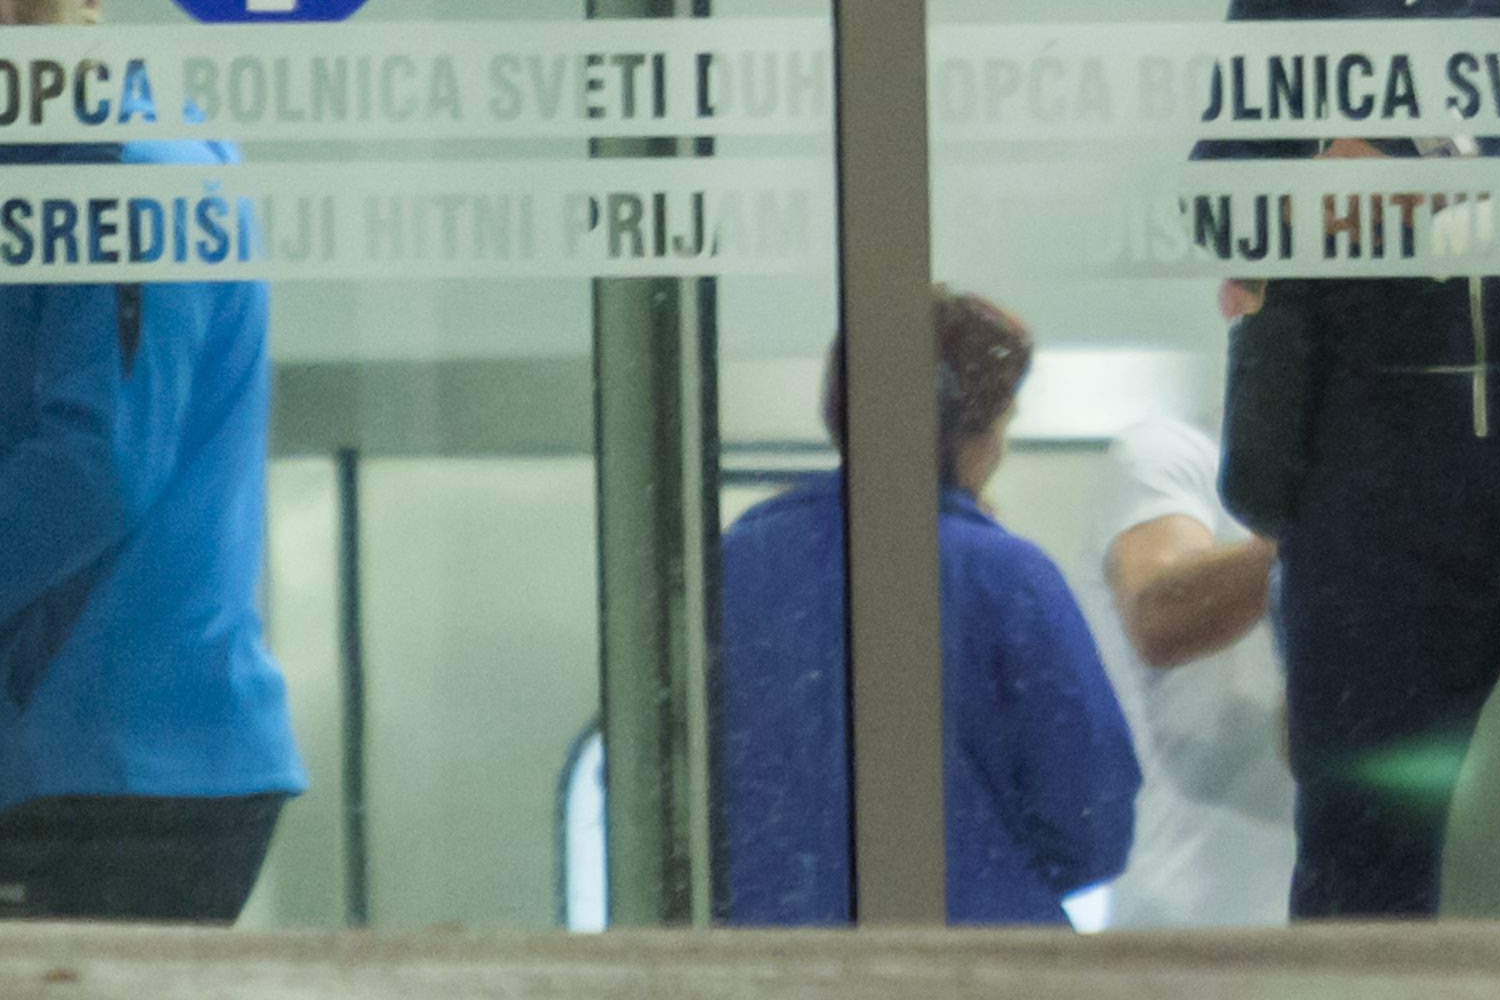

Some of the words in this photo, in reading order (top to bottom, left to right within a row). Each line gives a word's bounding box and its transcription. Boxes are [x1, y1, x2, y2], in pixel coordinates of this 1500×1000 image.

[183, 54, 463, 126] BOLNICA
[489, 51, 669, 122] SVETI
[694, 50, 824, 121] DUH
[1138, 50, 1423, 122] BOLNICA
[367, 192, 536, 261] HITNI
[563, 189, 809, 260] PRIJAM
